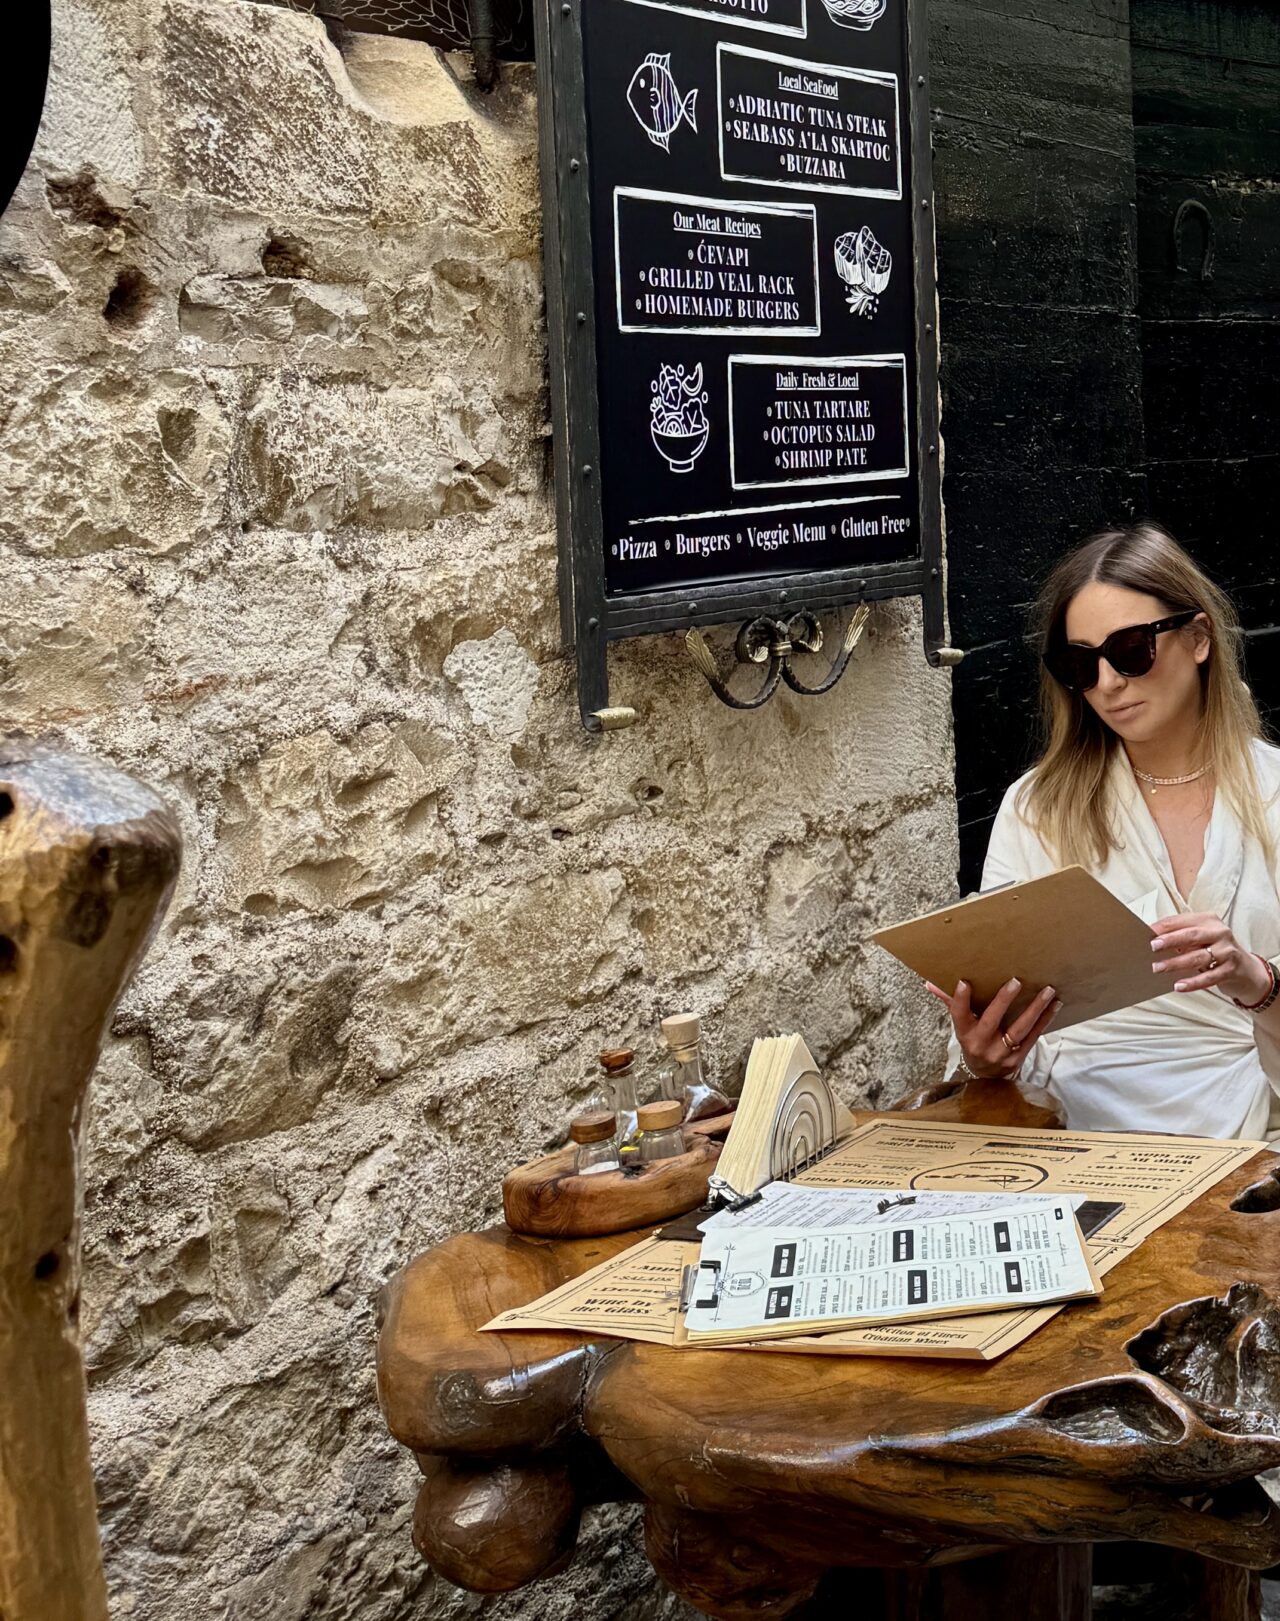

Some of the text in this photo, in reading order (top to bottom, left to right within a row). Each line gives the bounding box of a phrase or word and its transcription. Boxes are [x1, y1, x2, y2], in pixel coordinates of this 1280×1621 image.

[778, 71, 801, 88] Local
[736, 94, 887, 137] ADRIATIC TUNA STEAK
[734, 120, 795, 147] SEABASS
[831, 136, 890, 161] SKARTOC
[787, 156, 845, 179] BUZZARA
[674, 211, 761, 236] Our Meat Recipes
[648, 266, 795, 295] GRILLED VEAL RACK
[645, 294, 799, 320] HOMEMADE BURGERS
[776, 372, 859, 389] Daily Fresh & Local
[775, 400, 870, 419] TUNA TARTARE
[772, 424, 875, 444] OCTOPUS SALAD
[782, 448, 867, 469] SHRIMP PATE
[747, 523, 826, 549] Veggie Menu
[841, 515, 905, 539] Gluten Free
[619, 537, 657, 561] Pizza
[676, 533, 730, 558] Burgers
